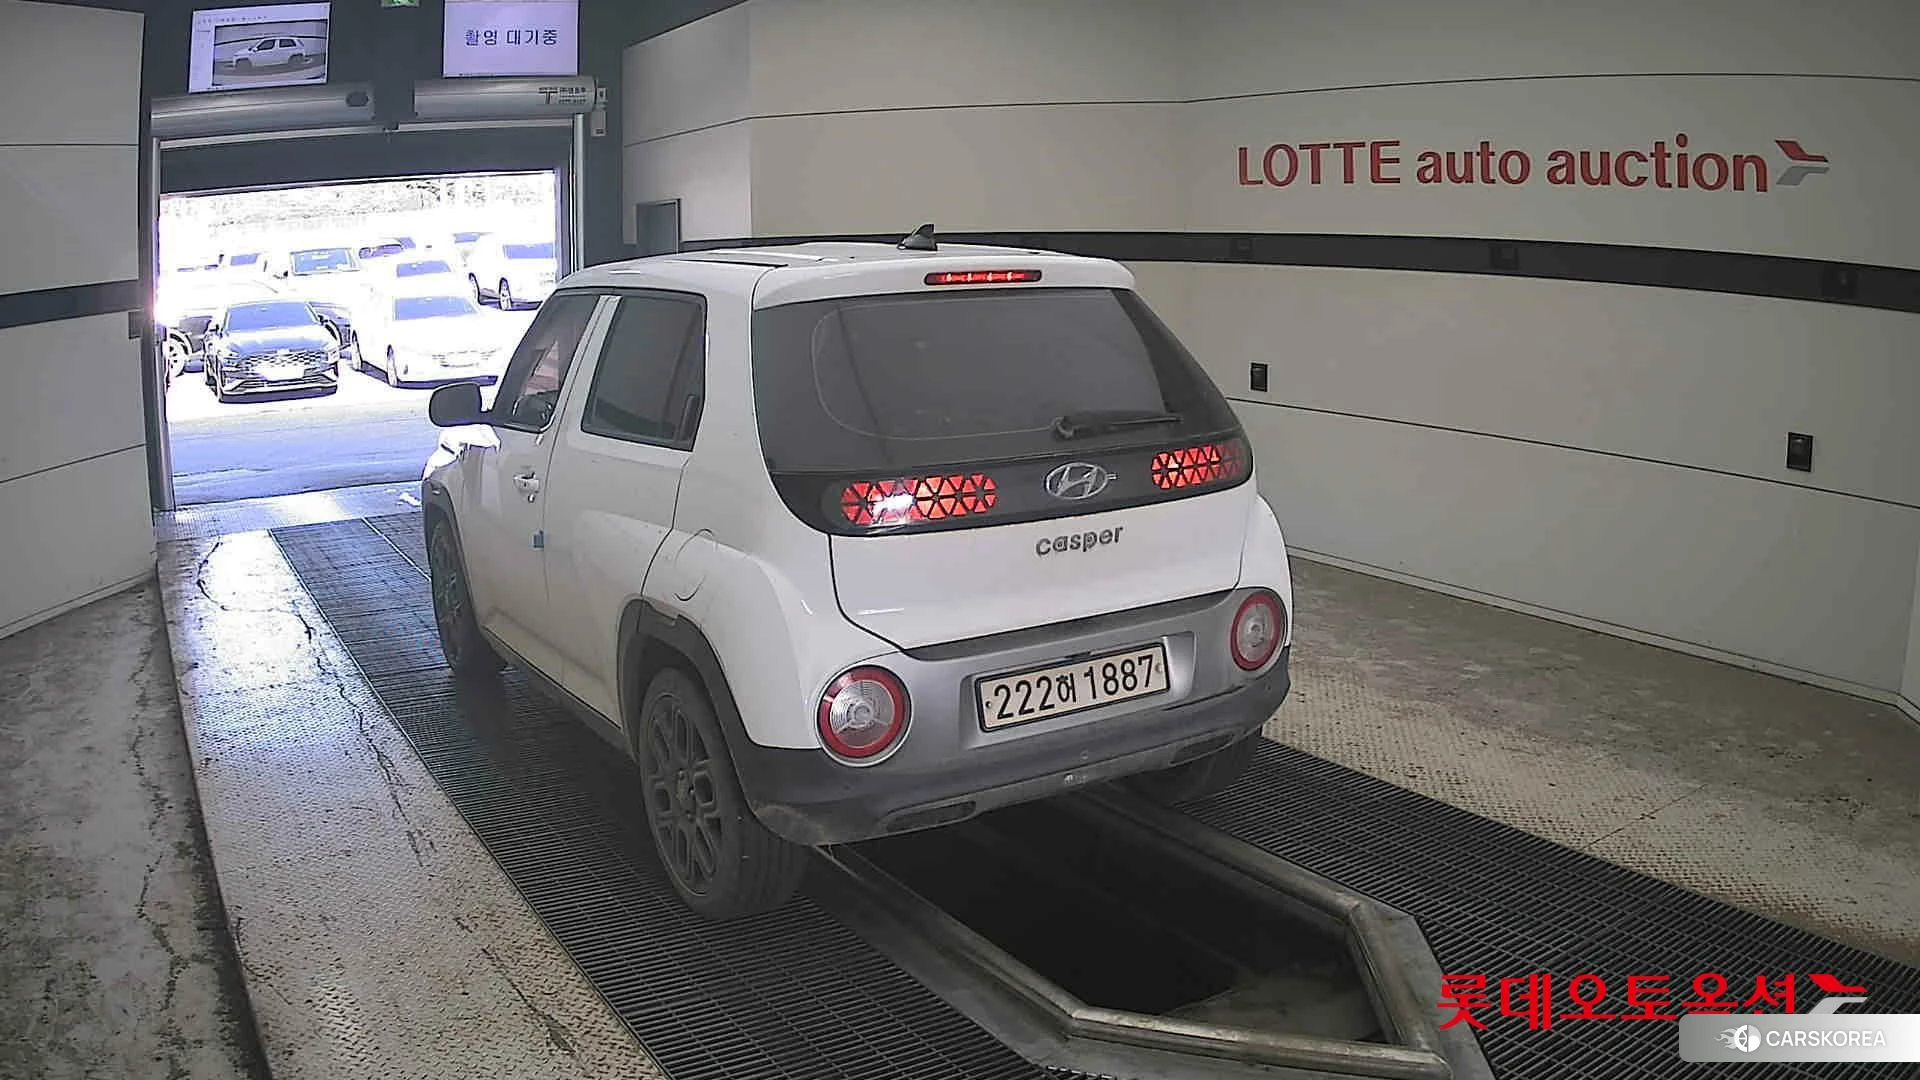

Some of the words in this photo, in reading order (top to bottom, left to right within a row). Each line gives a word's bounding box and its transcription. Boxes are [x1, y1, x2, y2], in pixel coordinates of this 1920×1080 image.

[465, 29, 498, 46] 촬영
[506, 29, 558, 46] 대기중
[1238, 140, 1400, 187] LOTTE
[1416, 141, 1531, 184] auto
[1546, 133, 1768, 192] auction
[1036, 526, 1123, 556] casper
[1084, 654, 1153, 700] 1887
